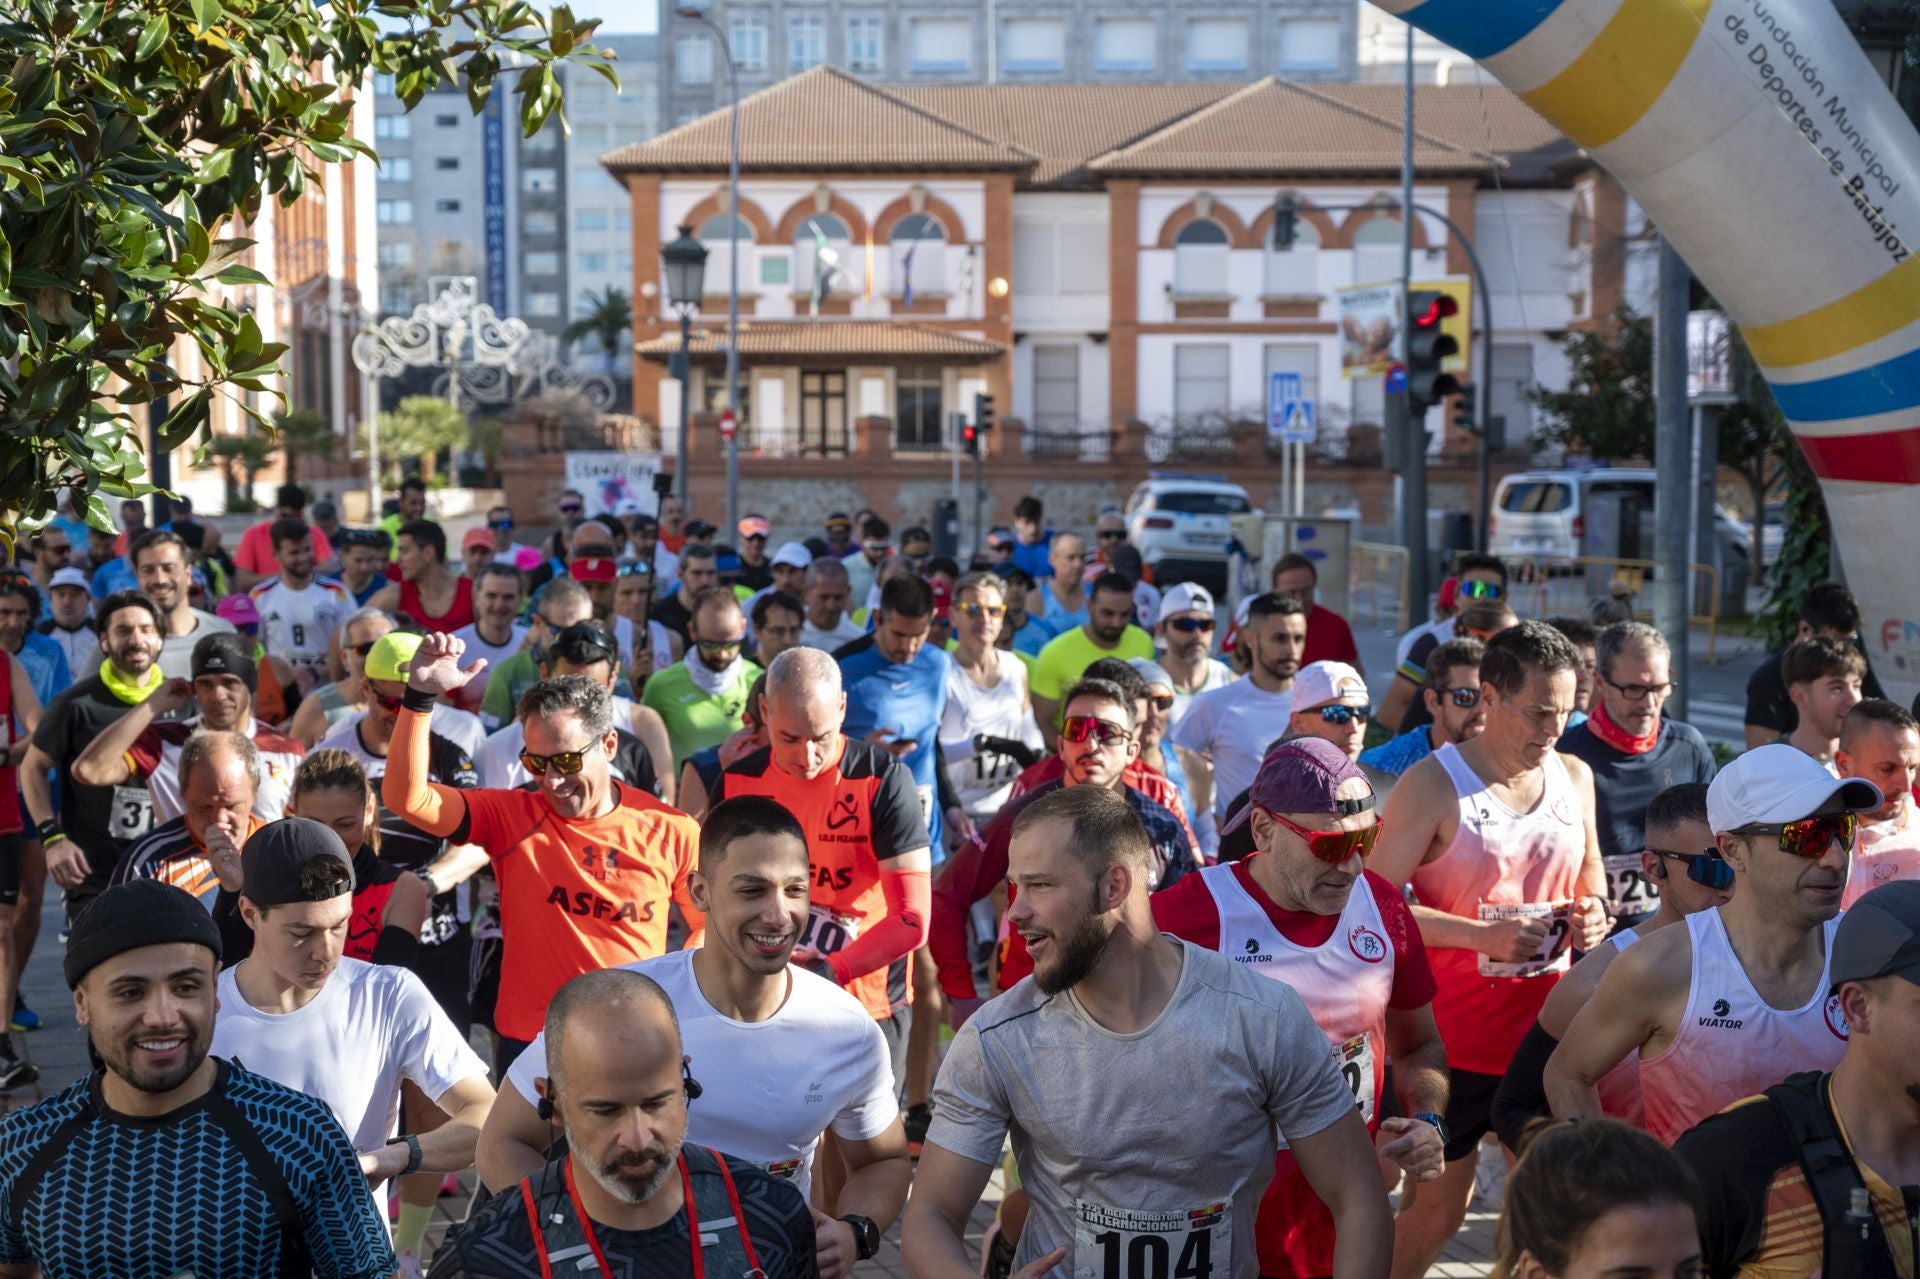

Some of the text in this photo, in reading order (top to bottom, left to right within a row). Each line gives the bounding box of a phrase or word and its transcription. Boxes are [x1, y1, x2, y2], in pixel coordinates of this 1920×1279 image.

[1745, 0, 1901, 198] undación Municipal
[1724, 14, 1910, 263] de Deportes de Badajoz
[546, 886, 656, 923] ASFAS
[1235, 954, 1273, 964] VIATOR
[1698, 1017, 1743, 1030] VIATOR
[1085, 1212, 1184, 1233] INTERNACIONAL
[1095, 1228, 1214, 1279] 104
